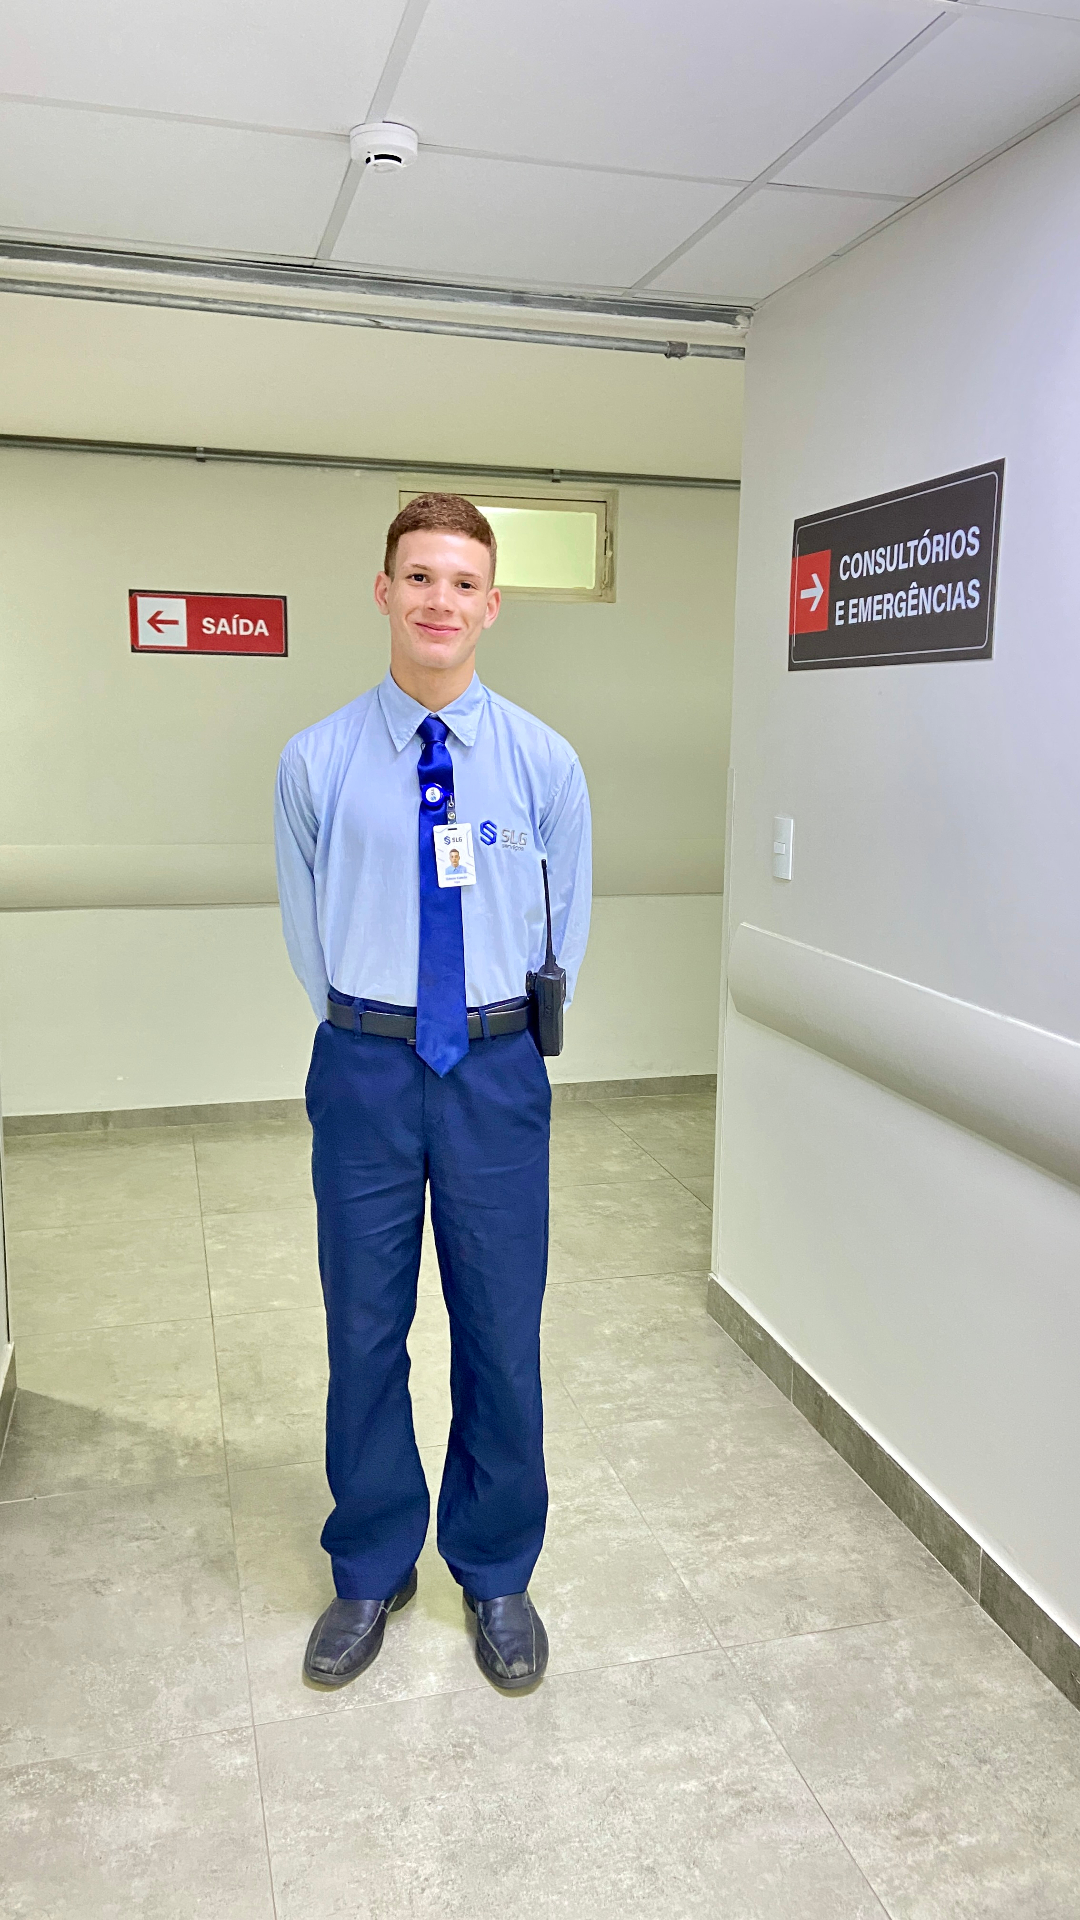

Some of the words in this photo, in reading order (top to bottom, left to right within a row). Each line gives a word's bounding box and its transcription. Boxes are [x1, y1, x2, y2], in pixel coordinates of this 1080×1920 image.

[839, 526, 980, 581] CONSULTÓRIOS
[835, 600, 845, 626] E
[848, 578, 980, 625] EMERGÊNCIAS
[202, 614, 269, 636] SAÍDA
[501, 829, 527, 845] SLG
